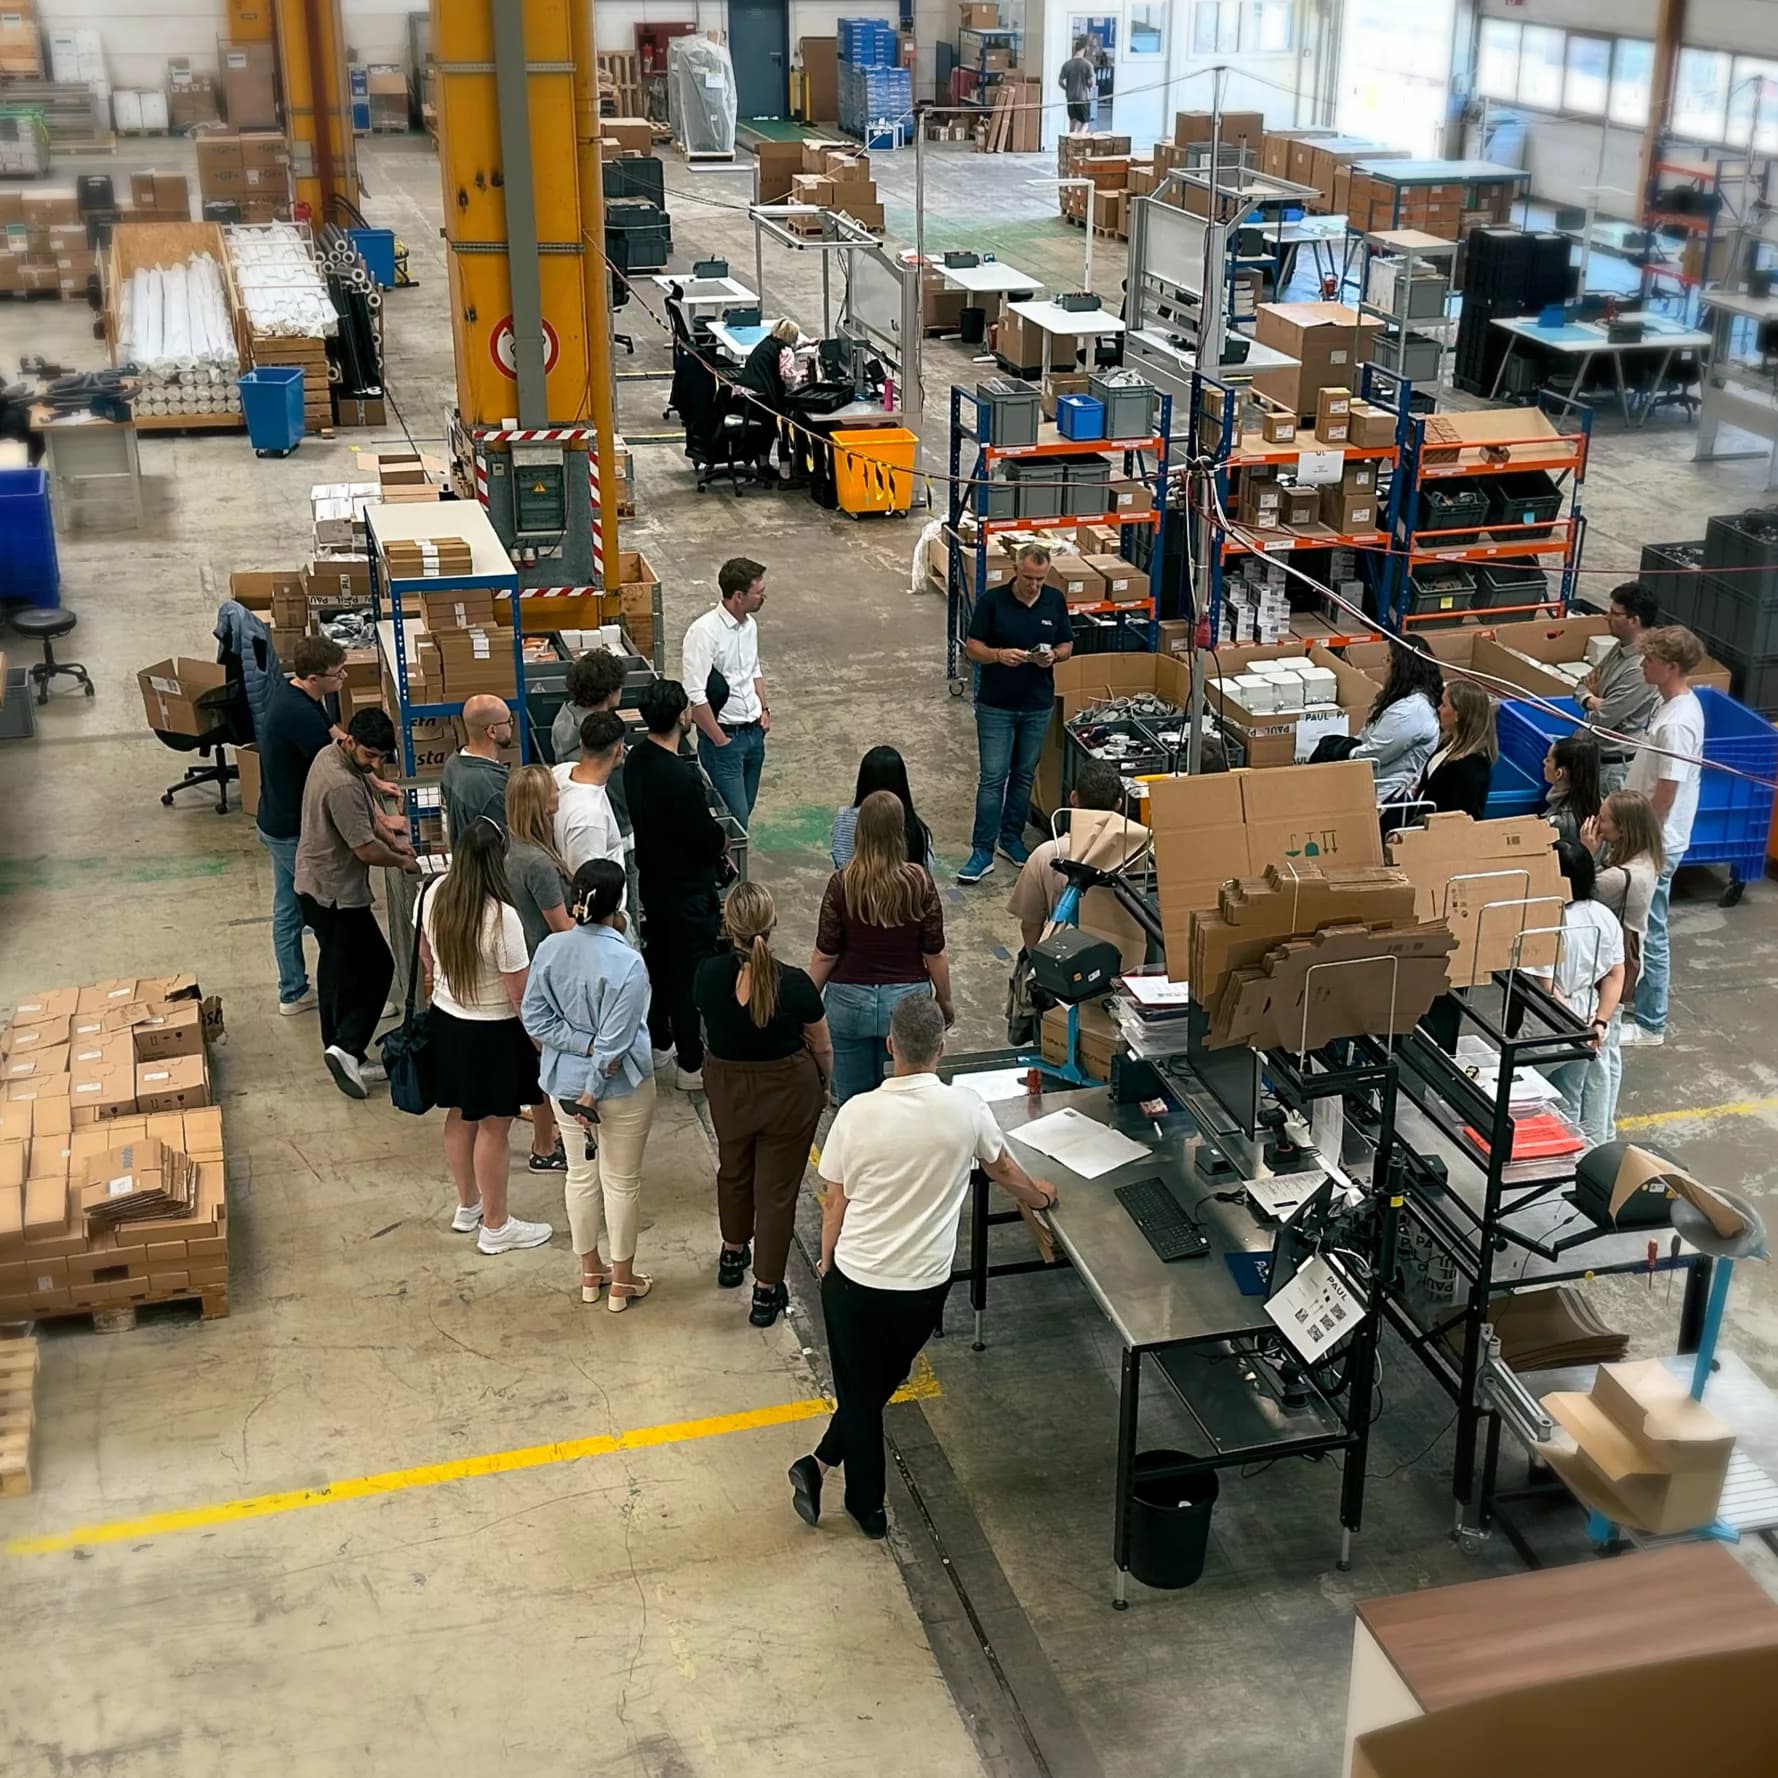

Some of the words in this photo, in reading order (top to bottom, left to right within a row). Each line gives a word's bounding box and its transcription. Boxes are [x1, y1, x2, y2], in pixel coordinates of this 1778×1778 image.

[1304, 712, 1329, 722] PAUL
[1265, 725, 1290, 736] PAUL
[1327, 1275, 1349, 1302] PAUL
